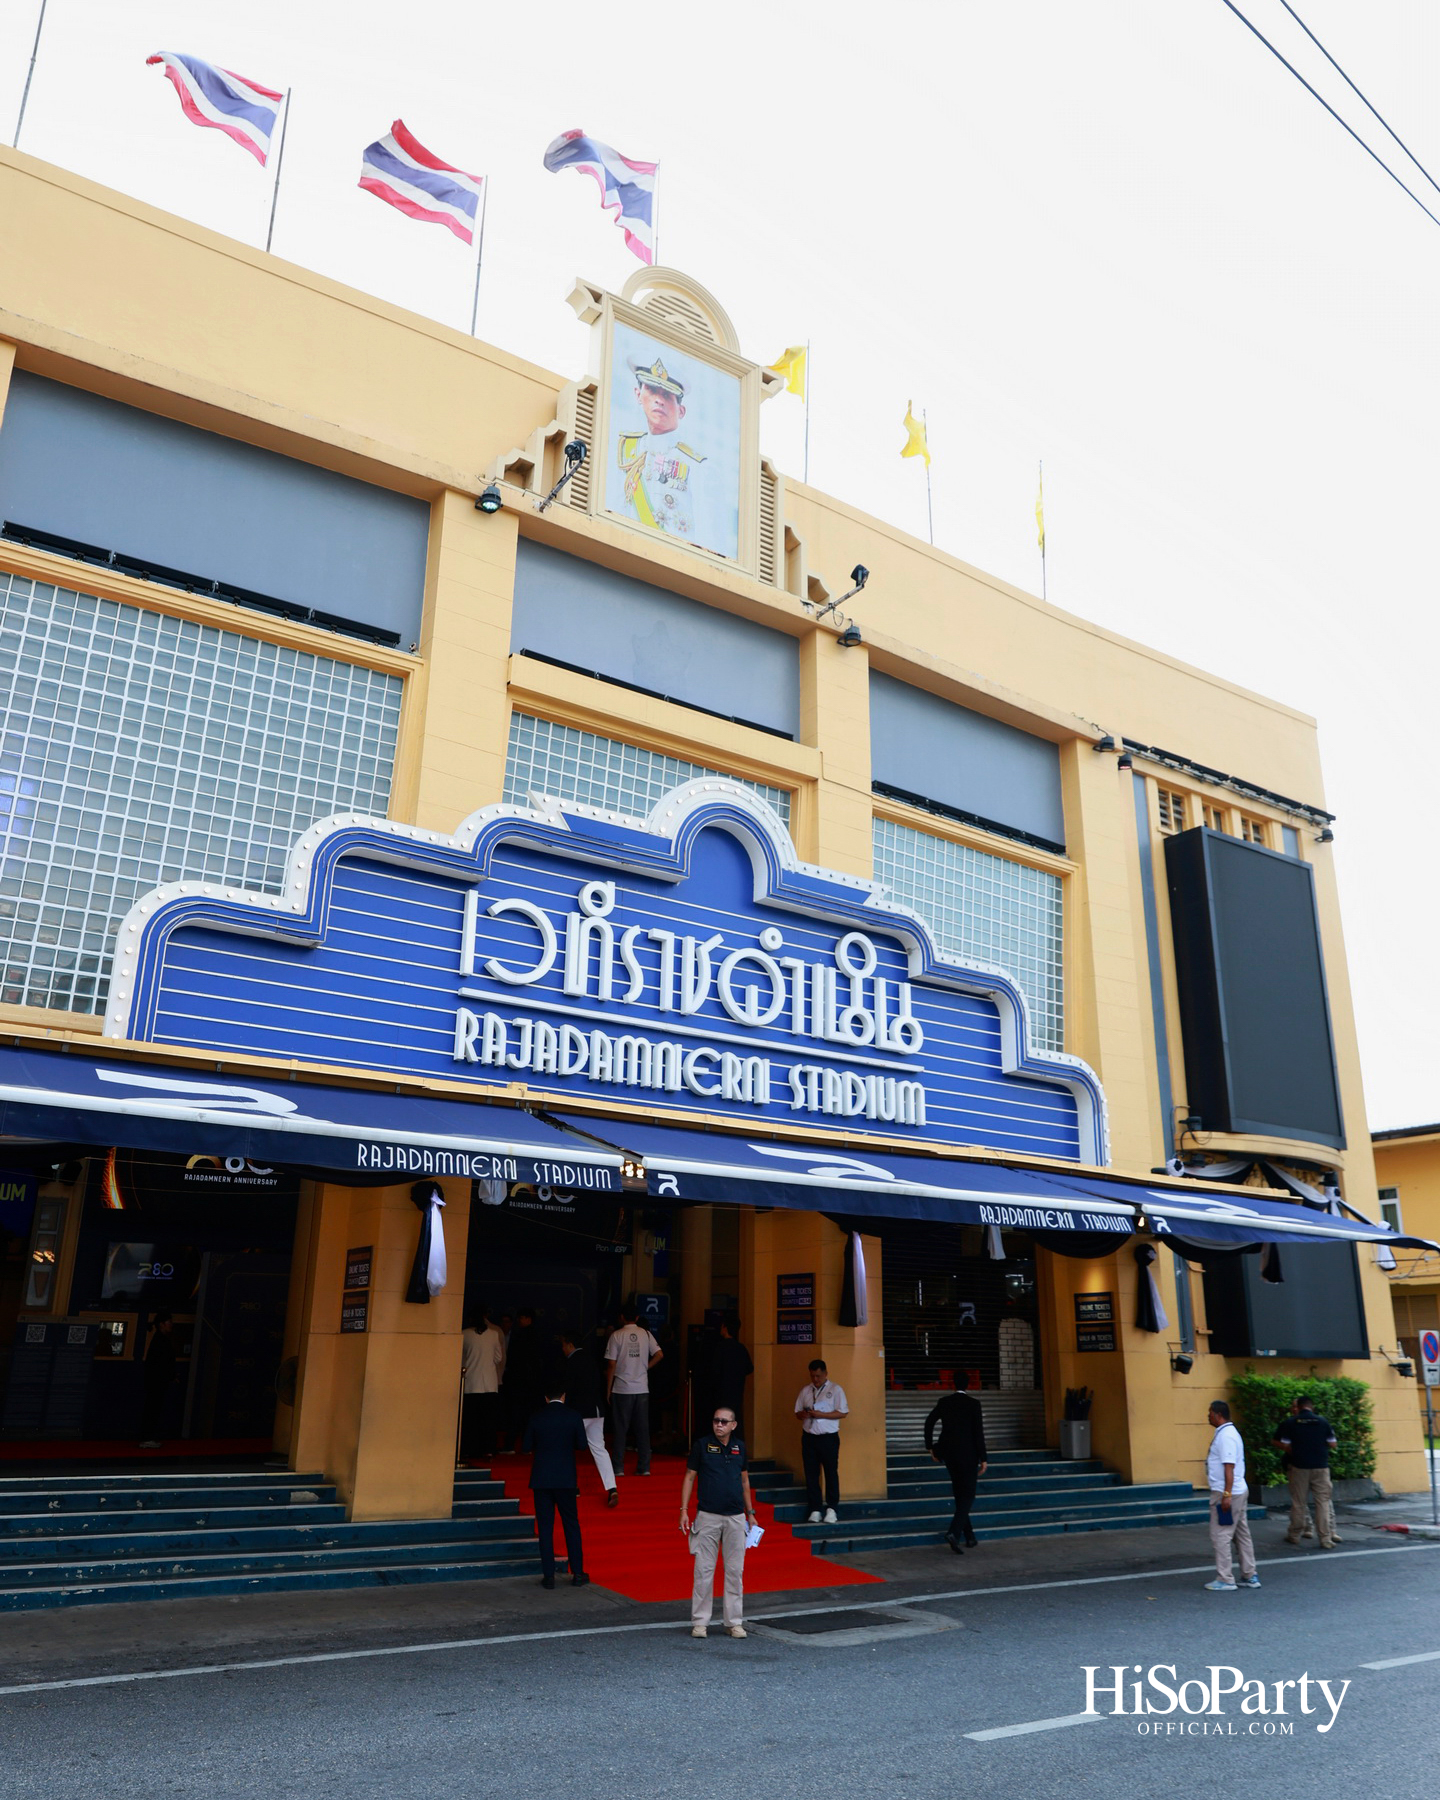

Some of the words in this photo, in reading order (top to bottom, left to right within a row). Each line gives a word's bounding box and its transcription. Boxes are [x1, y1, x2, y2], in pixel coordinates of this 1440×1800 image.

[454, 1007, 771, 1105] RAJADAMNERN
[788, 1064, 926, 1127] STADIUM
[357, 1143, 518, 1181] RAJADAMNERN
[533, 1162, 612, 1189] STADIUM
[184, 1173, 231, 1184] RAJADAMNERN
[233, 1177, 278, 1186] ANNIVERSARY
[508, 1200, 544, 1211] RAJADAMNERN
[544, 1203, 576, 1214] ANNIVERSARY
[979, 1204, 1075, 1229] RAJADAMNERN
[1081, 1214, 1132, 1232] STADIUM
[782, 1288, 796, 1296] ONLINE
[797, 1287, 812, 1295] TICKETS
[797, 1323, 812, 1331] TICKETS
